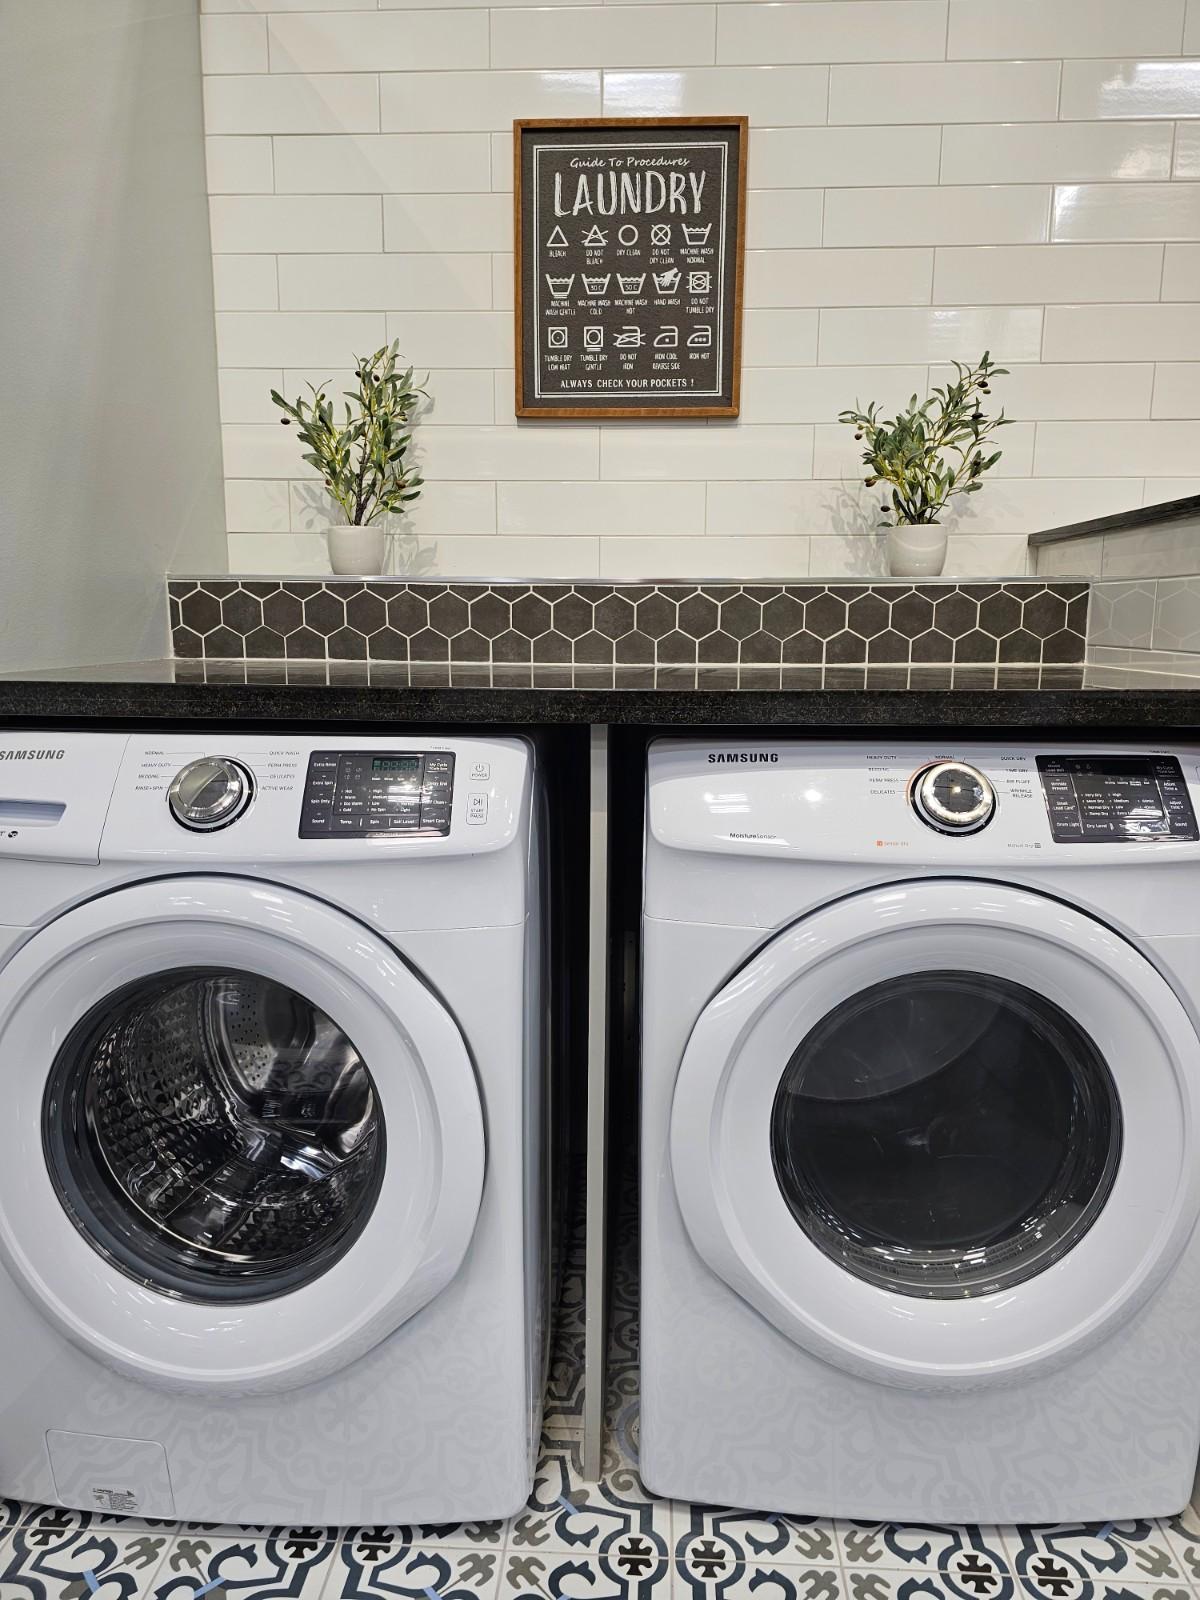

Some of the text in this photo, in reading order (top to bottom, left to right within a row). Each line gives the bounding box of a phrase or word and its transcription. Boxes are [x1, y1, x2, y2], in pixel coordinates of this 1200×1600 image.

[570, 156, 690, 168] Guide To Procedures
[554, 170, 706, 217] LAUNDRY
[585, 249, 604, 257] DO NOT
[652, 248, 659, 256] DO
[686, 256, 705, 264] NORMAL
[580, 354, 599, 362] TUMBLE
[559, 363, 571, 371] HEAT
[585, 363, 602, 371] GENTLE
[622, 362, 634, 370] IRON
[652, 362, 681, 370] REVERSE SIDE
[560, 379, 593, 388] ALWAYS
[596, 379, 624, 388] CHECK
[625, 378, 648, 388] YOUR
[650, 378, 687, 388] POCKETS
[0, 750, 65, 760] SAMSUNG
[708, 753, 779, 763] SAMSUNG
